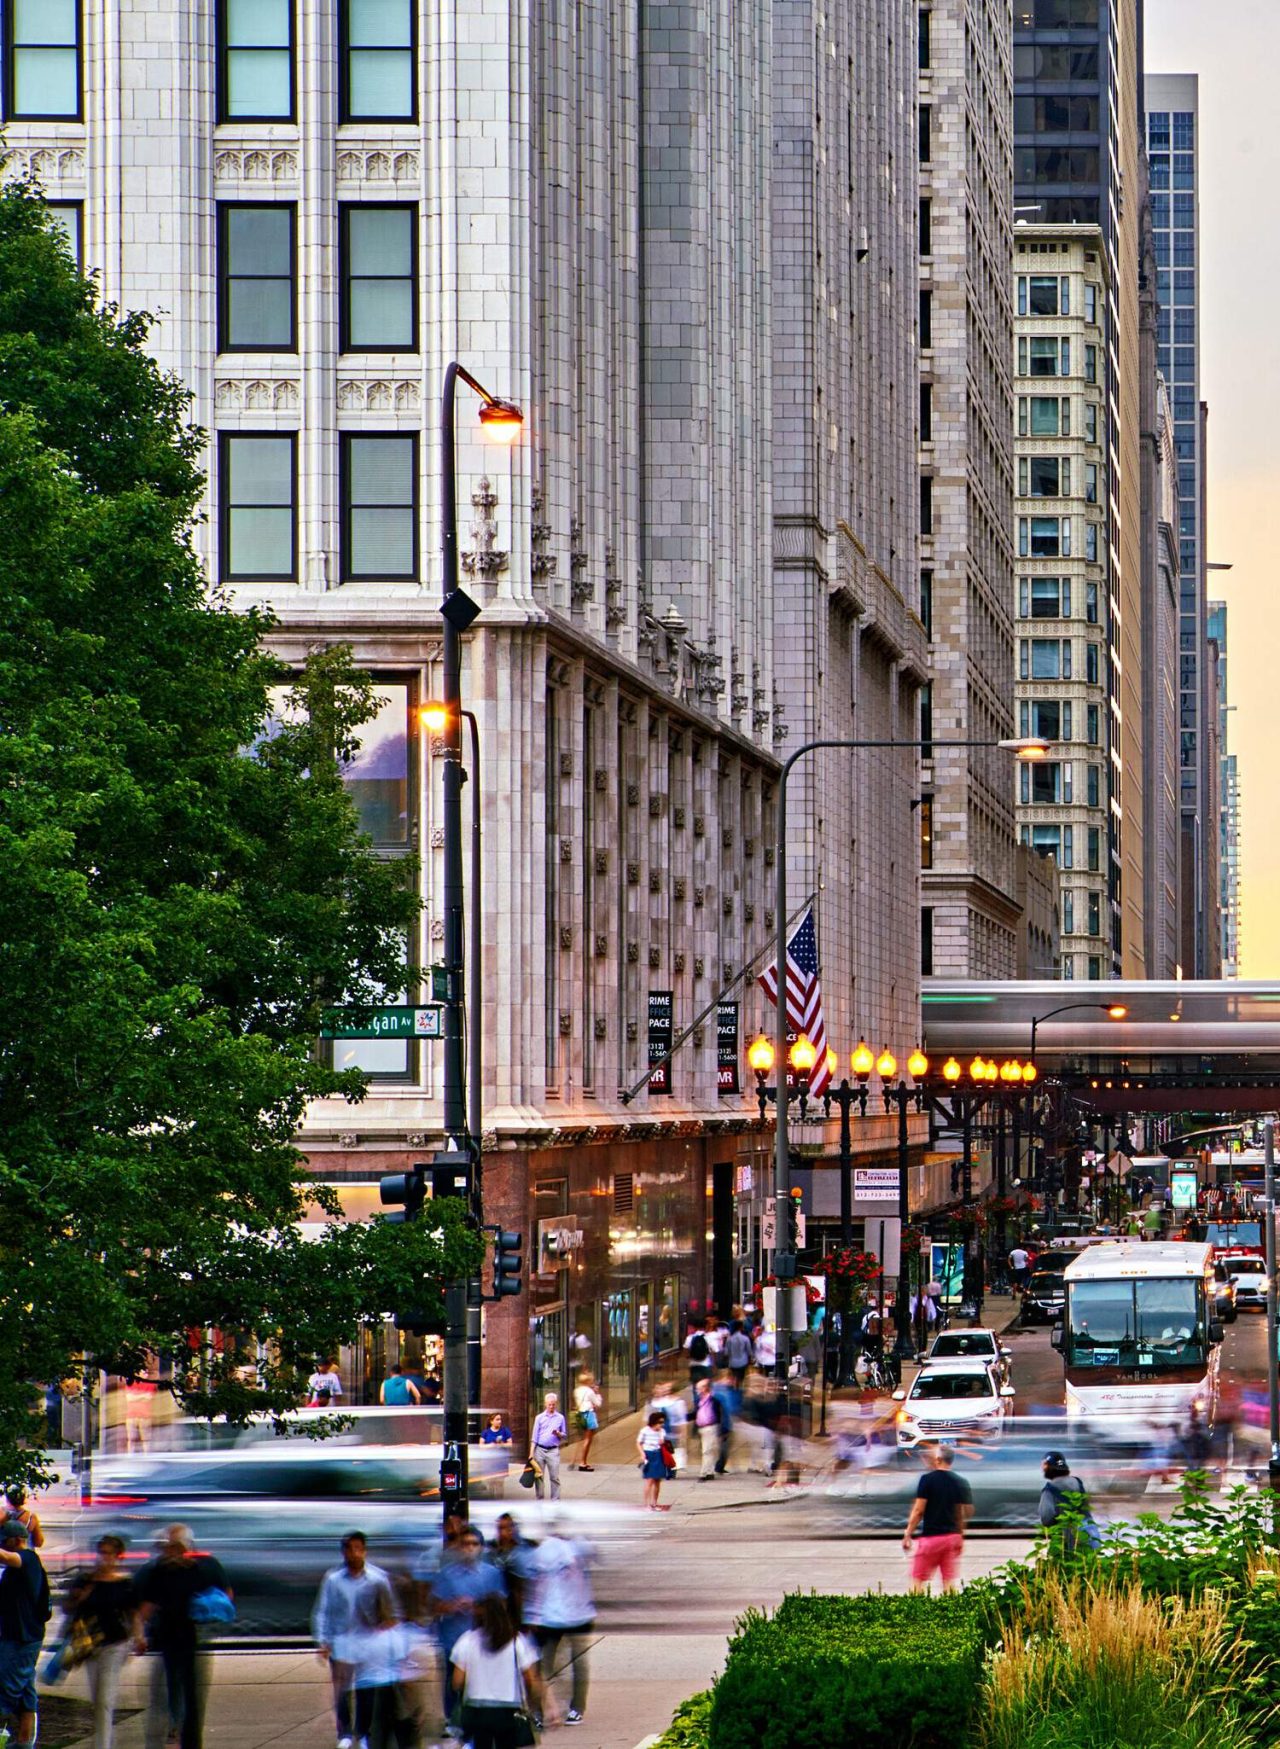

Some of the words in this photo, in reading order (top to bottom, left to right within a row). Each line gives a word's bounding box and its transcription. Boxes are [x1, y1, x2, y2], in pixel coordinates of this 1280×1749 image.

[649, 996, 670, 1005] RIME
[649, 1007, 671, 1016] FFICE
[718, 1006, 736, 1014] RIME
[401, 1017, 411, 1026] Av
[649, 1018, 670, 1027] PACE
[718, 1026, 736, 1034] PACE
